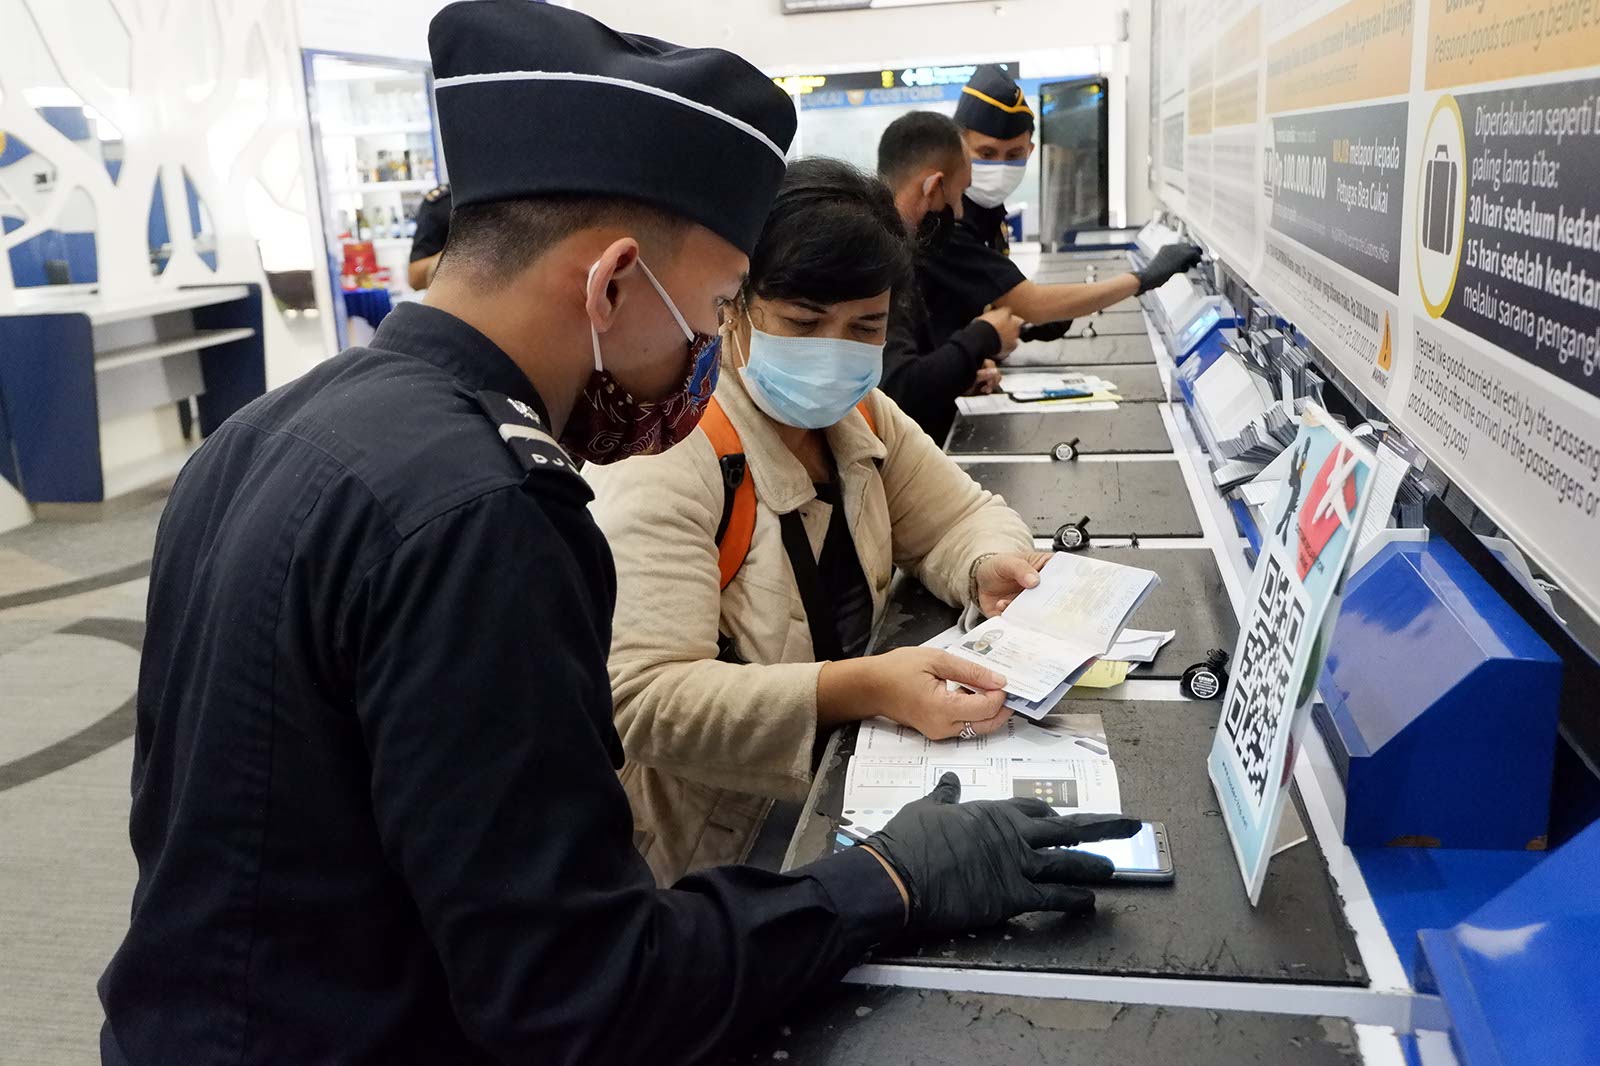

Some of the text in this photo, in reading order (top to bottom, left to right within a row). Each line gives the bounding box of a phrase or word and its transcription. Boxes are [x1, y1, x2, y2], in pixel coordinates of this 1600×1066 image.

[1434, 21, 1469, 63] Personal
[1469, 14, 1500, 64] goods
[1501, 5, 1544, 52] coming
[1475, 99, 1543, 143] Diperlakukan
[1544, 95, 1594, 145] seperti
[1349, 137, 1374, 173] melapor
[1374, 137, 1400, 176] kepada
[1471, 148, 1560, 191] paling lama tiba:
[1336, 177, 1389, 214] Petugas Bea Cukai
[1469, 195, 1480, 224] 30
[1482, 193, 1503, 228] hari
[1503, 198, 1555, 240] sebelum
[1466, 239, 1478, 268] 15
[1478, 238, 1500, 275] hari
[1500, 249, 1543, 290] setelah
[1464, 282, 1498, 320] melalui
[1499, 300, 1534, 338] sarana
[1415, 330, 1436, 362] Treated
[1447, 356, 1466, 383] goods
[1467, 369, 1492, 400] carried
[1492, 377, 1524, 428] directly
[1524, 398, 1536, 436] by
[1537, 406, 1553, 442] the
[1553, 425, 1600, 482] passeng
[1424, 400, 1452, 447] boarding
[1434, 373, 1448, 406] days
[1448, 385, 1464, 414] after
[1464, 395, 1475, 424] the
[1475, 410, 1501, 444] arrival
[1502, 424, 1513, 450] of
[1511, 430, 1525, 463] the
[1525, 447, 1584, 508] passengers
[1585, 491, 1600, 518] or
